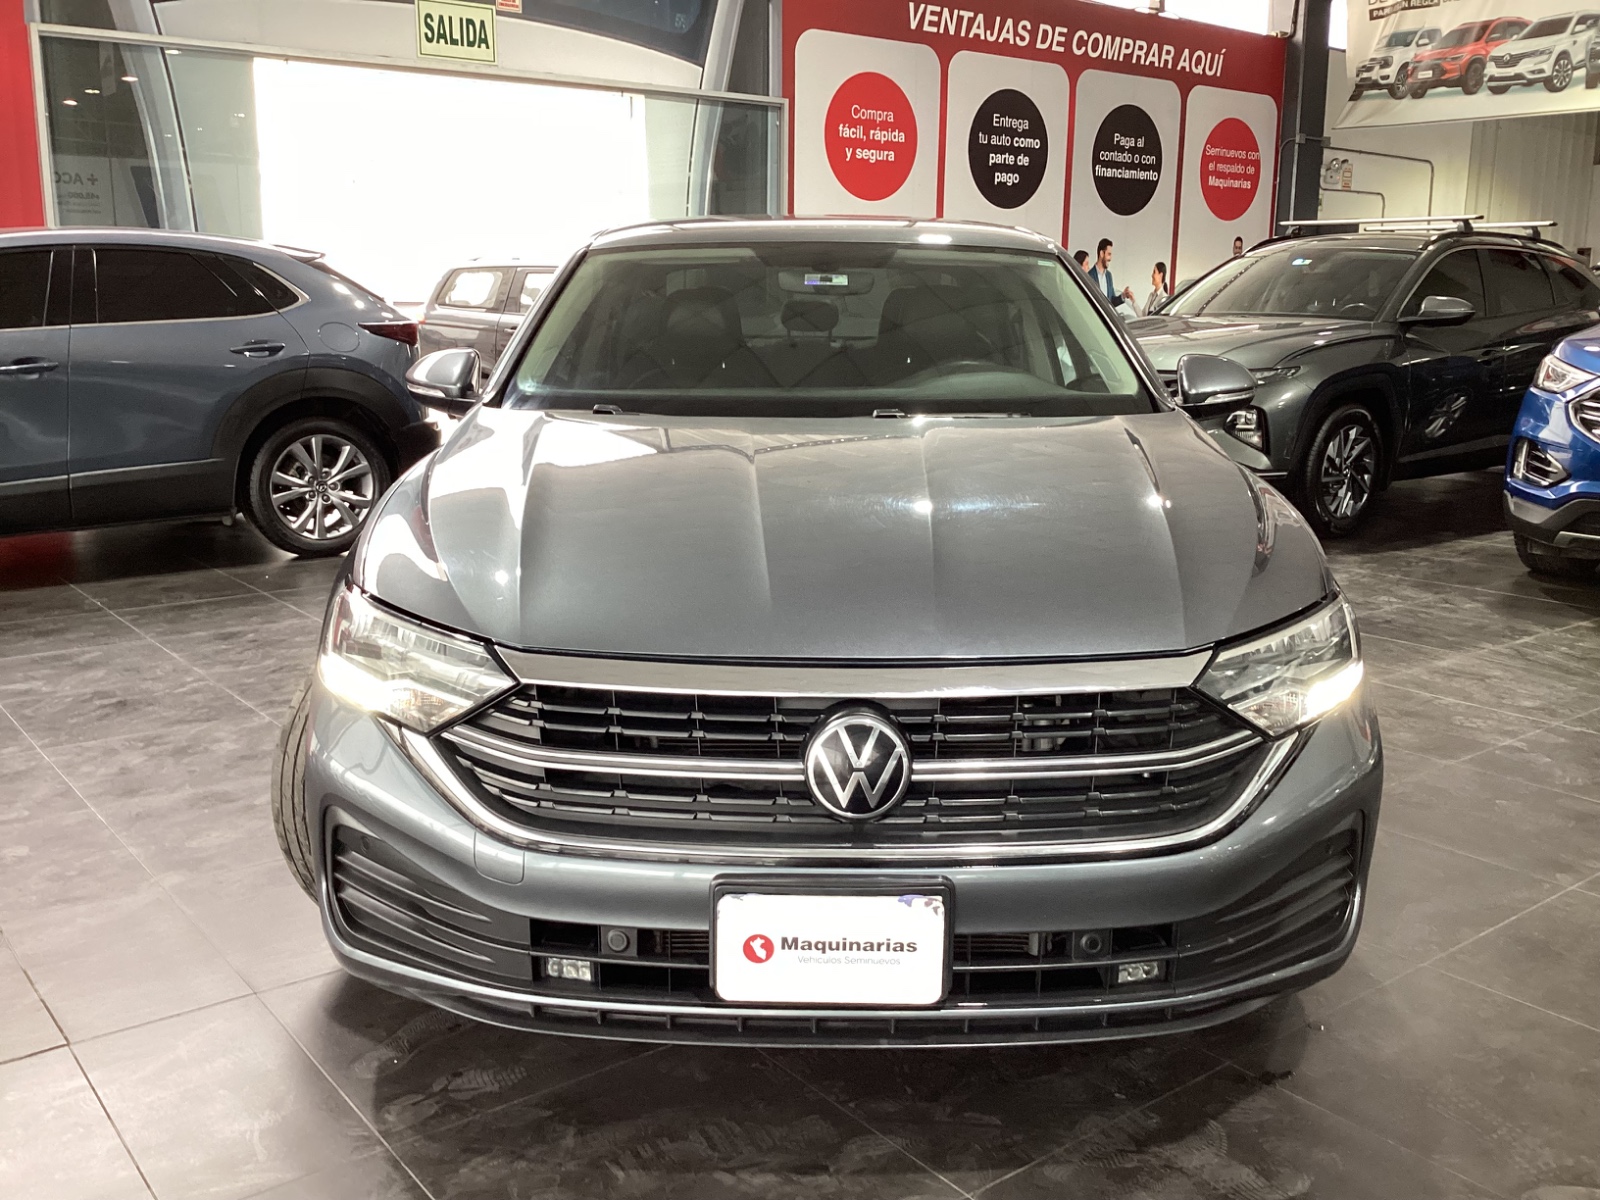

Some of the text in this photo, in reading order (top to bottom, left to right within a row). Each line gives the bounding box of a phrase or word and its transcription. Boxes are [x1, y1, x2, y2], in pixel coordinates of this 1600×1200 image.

[424, 12, 490, 50] SALIDA
[909, 2, 1227, 77] VENTAJAS DE COMPRAR AQUÍ
[851, 104, 894, 124] Compra
[993, 113, 1029, 132] Entrega
[838, 123, 905, 144] fácil, rápida
[979, 131, 1041, 149] tu auto como
[1114, 133, 1145, 149] Paga al
[845, 147, 895, 163] y segura
[989, 152, 1030, 167] parte de
[1099, 150, 1156, 165] contado o con
[1205, 144, 1260, 160] Seminuevos con
[1095, 164, 1158, 181] financiamiento
[1208, 160, 1256, 175] el respaldo de
[994, 172, 1020, 186] pago
[1208, 175, 1252, 189] Maquinarias
[780, 936, 918, 954] Maquinarias
[844, 955, 901, 965] Seminuevos
